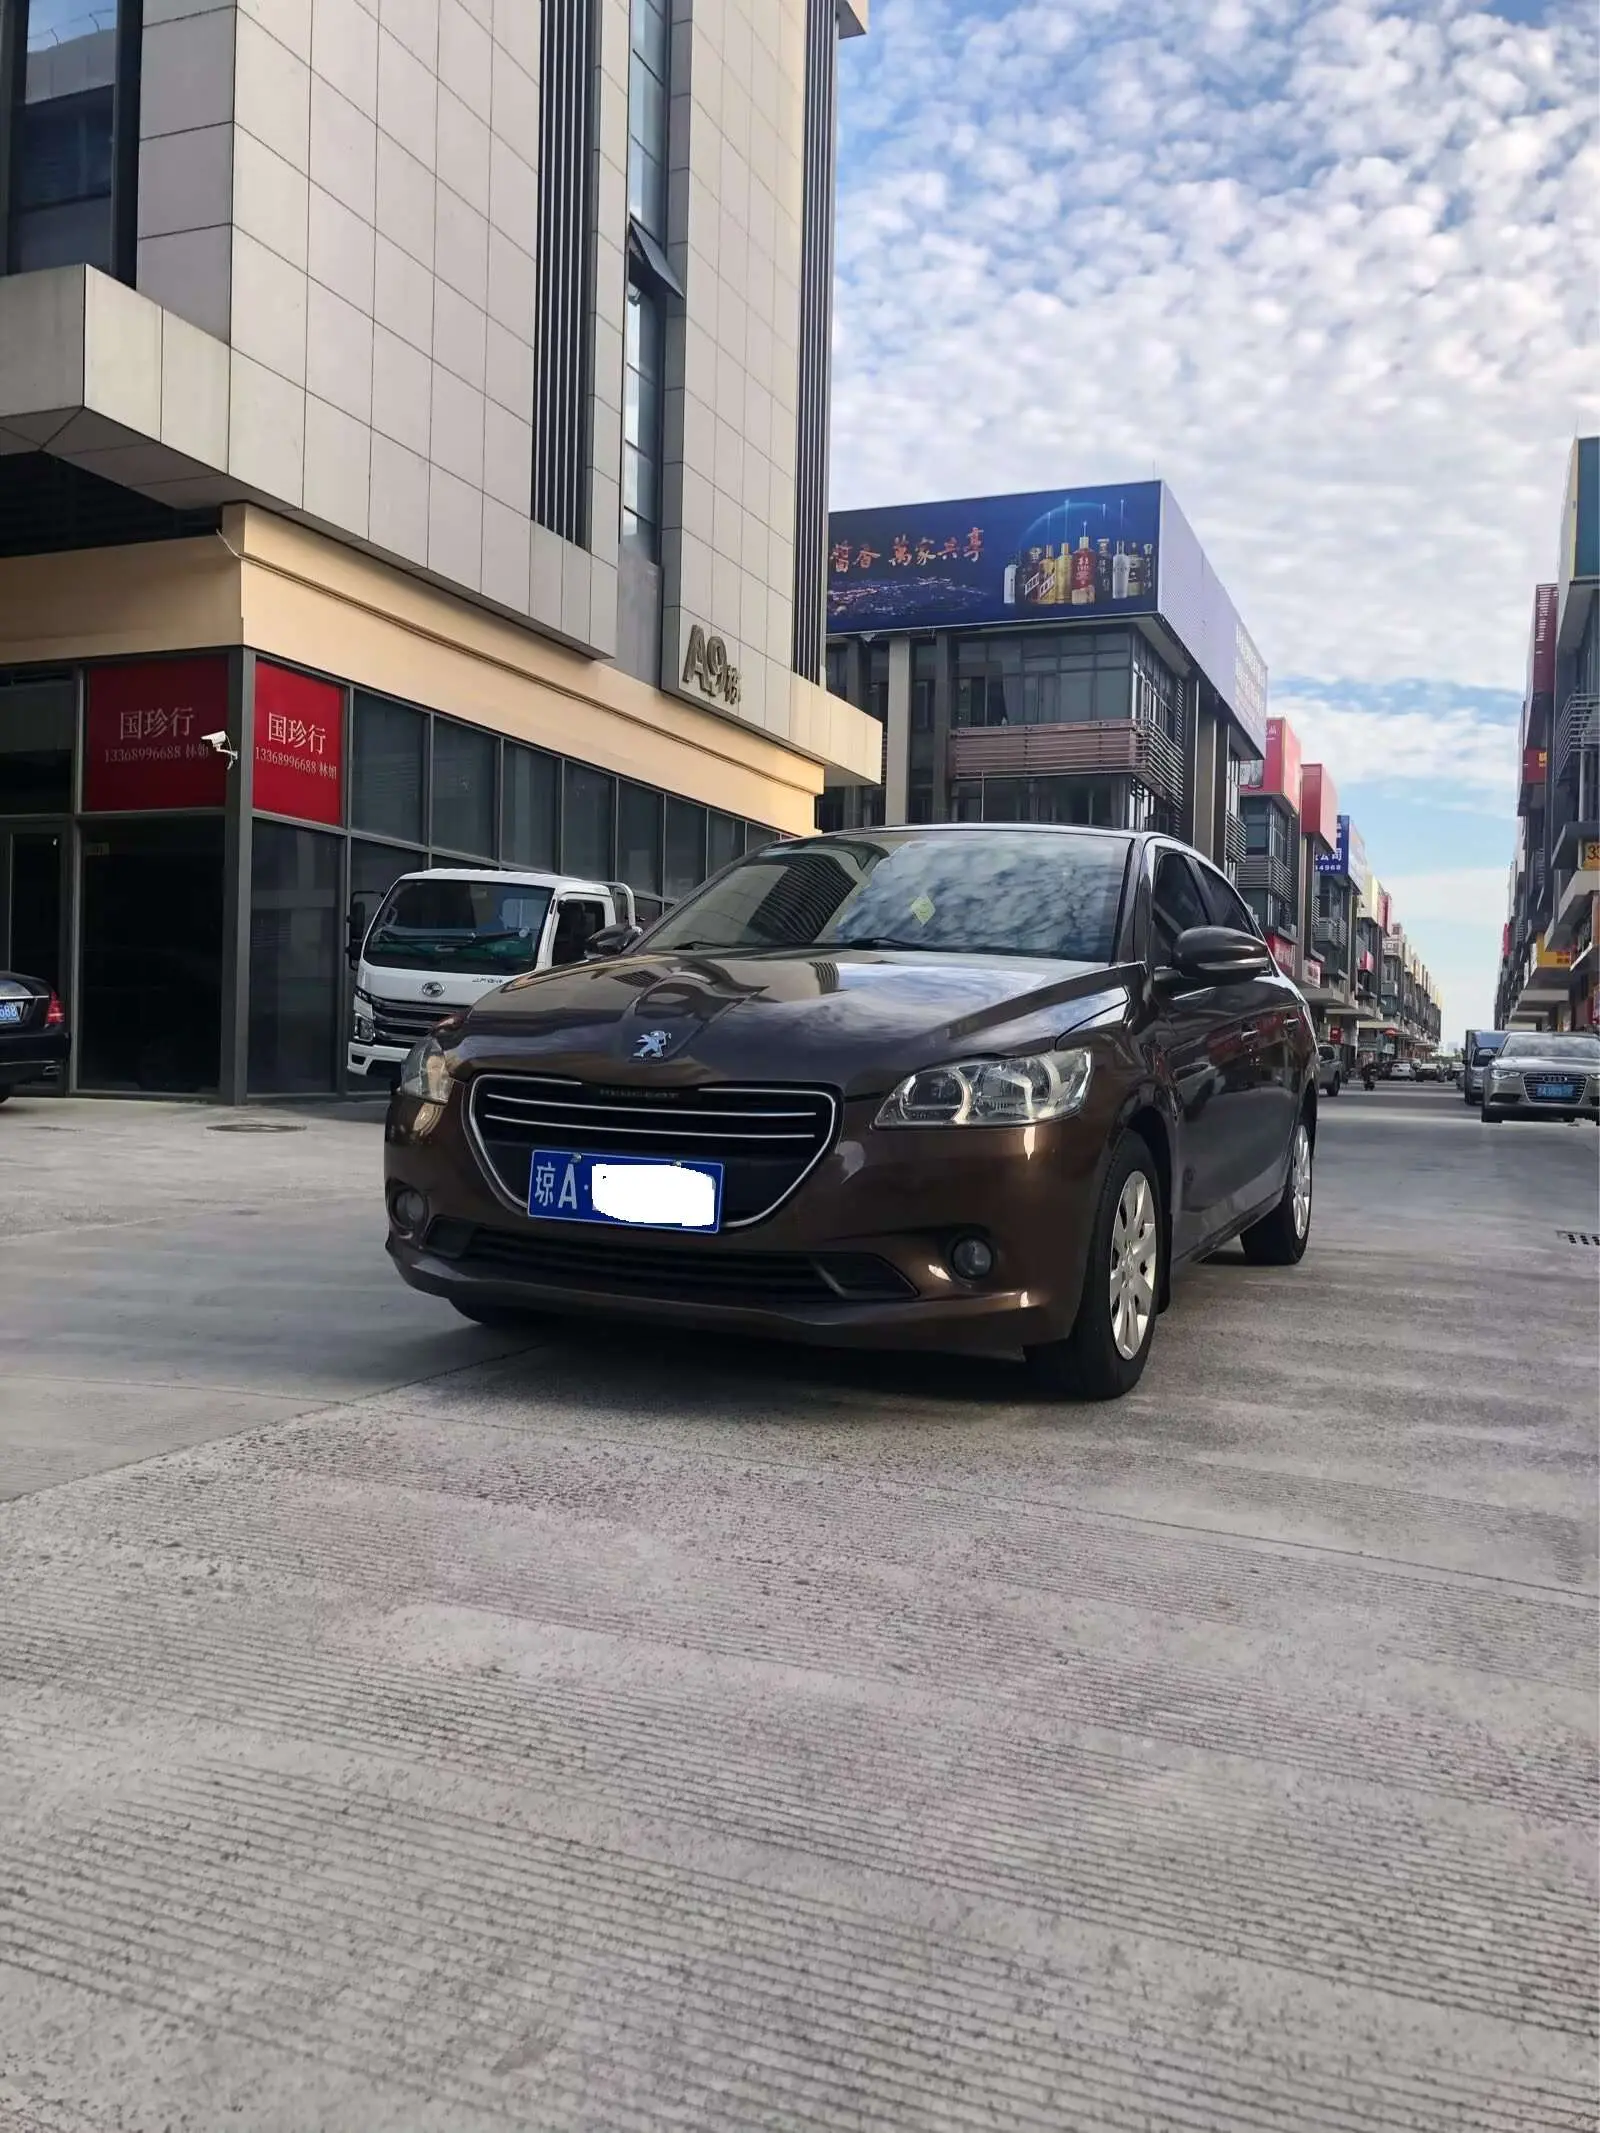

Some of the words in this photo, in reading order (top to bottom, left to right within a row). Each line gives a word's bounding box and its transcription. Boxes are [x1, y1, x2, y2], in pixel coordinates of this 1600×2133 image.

[120, 707, 195, 740] 国珍行
[268, 711, 326, 755] 国珍行
[255, 746, 317, 774] 13368996688
